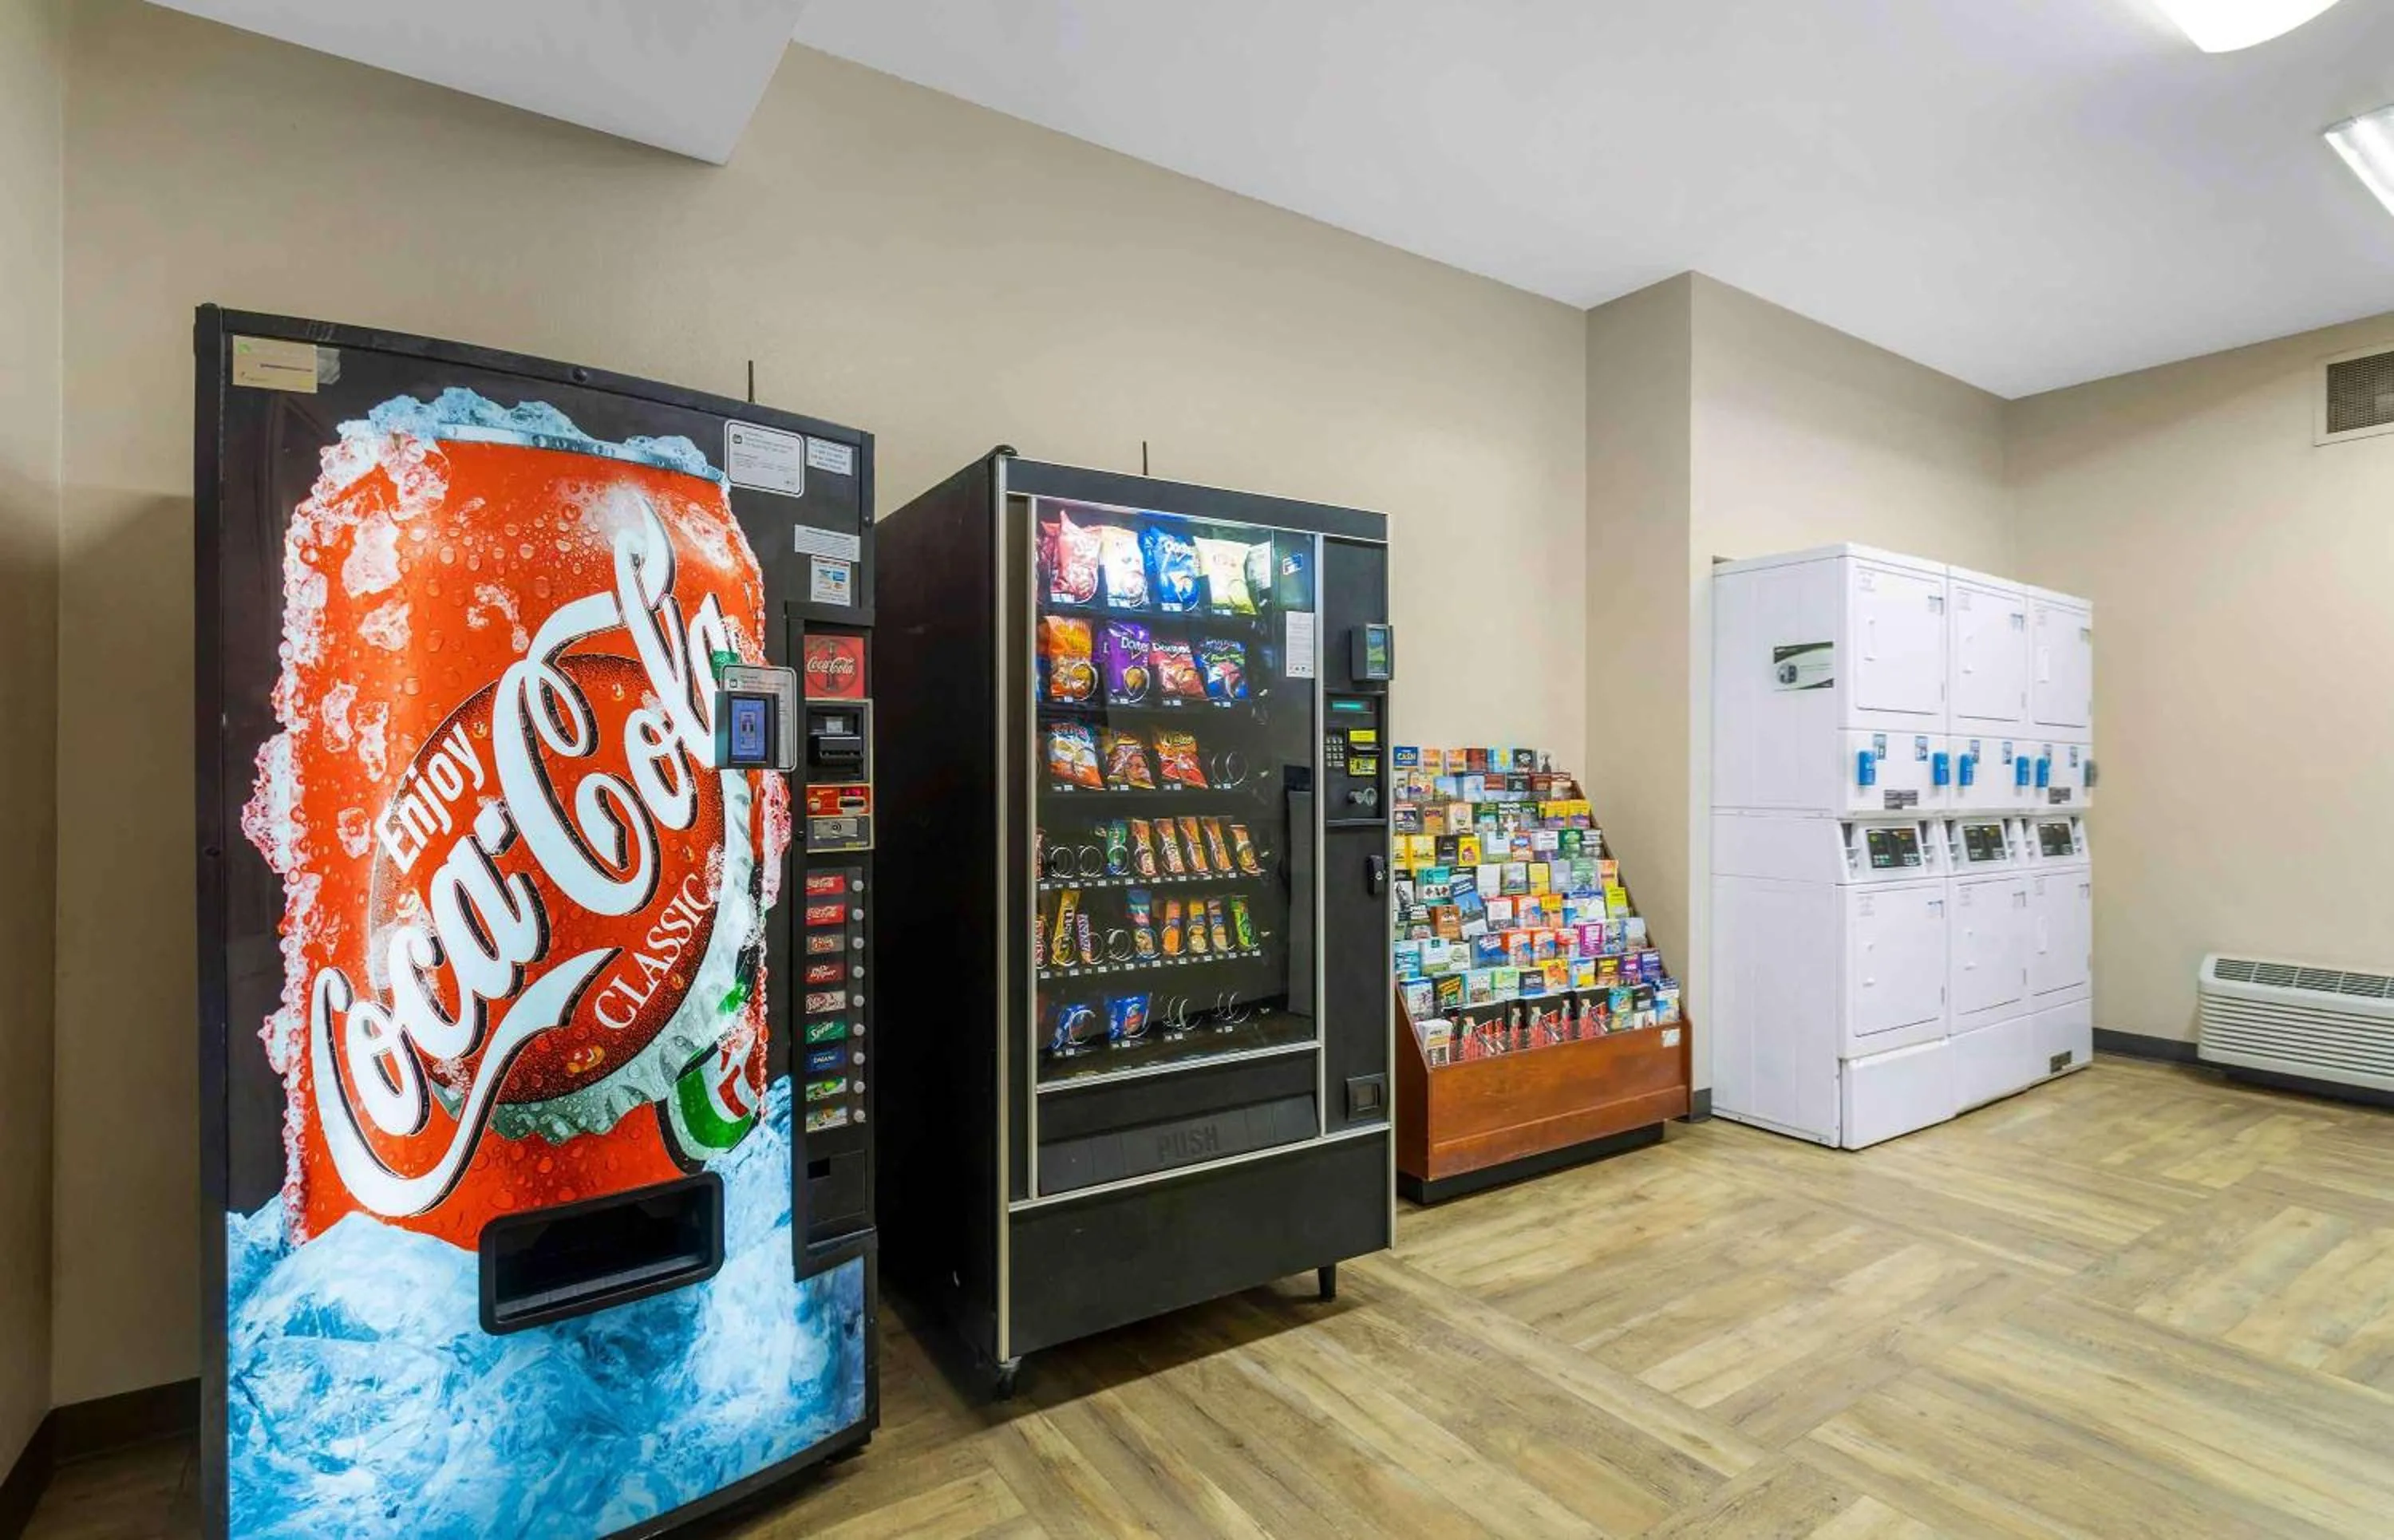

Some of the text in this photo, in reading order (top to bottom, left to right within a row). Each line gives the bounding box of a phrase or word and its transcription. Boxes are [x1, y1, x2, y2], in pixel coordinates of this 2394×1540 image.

[807, 656, 855, 677] Coca-Cola
[374, 723, 484, 874] Enjoy
[595, 874, 715, 1029] CLASSIC
[1157, 1123, 1219, 1163] PUSH
